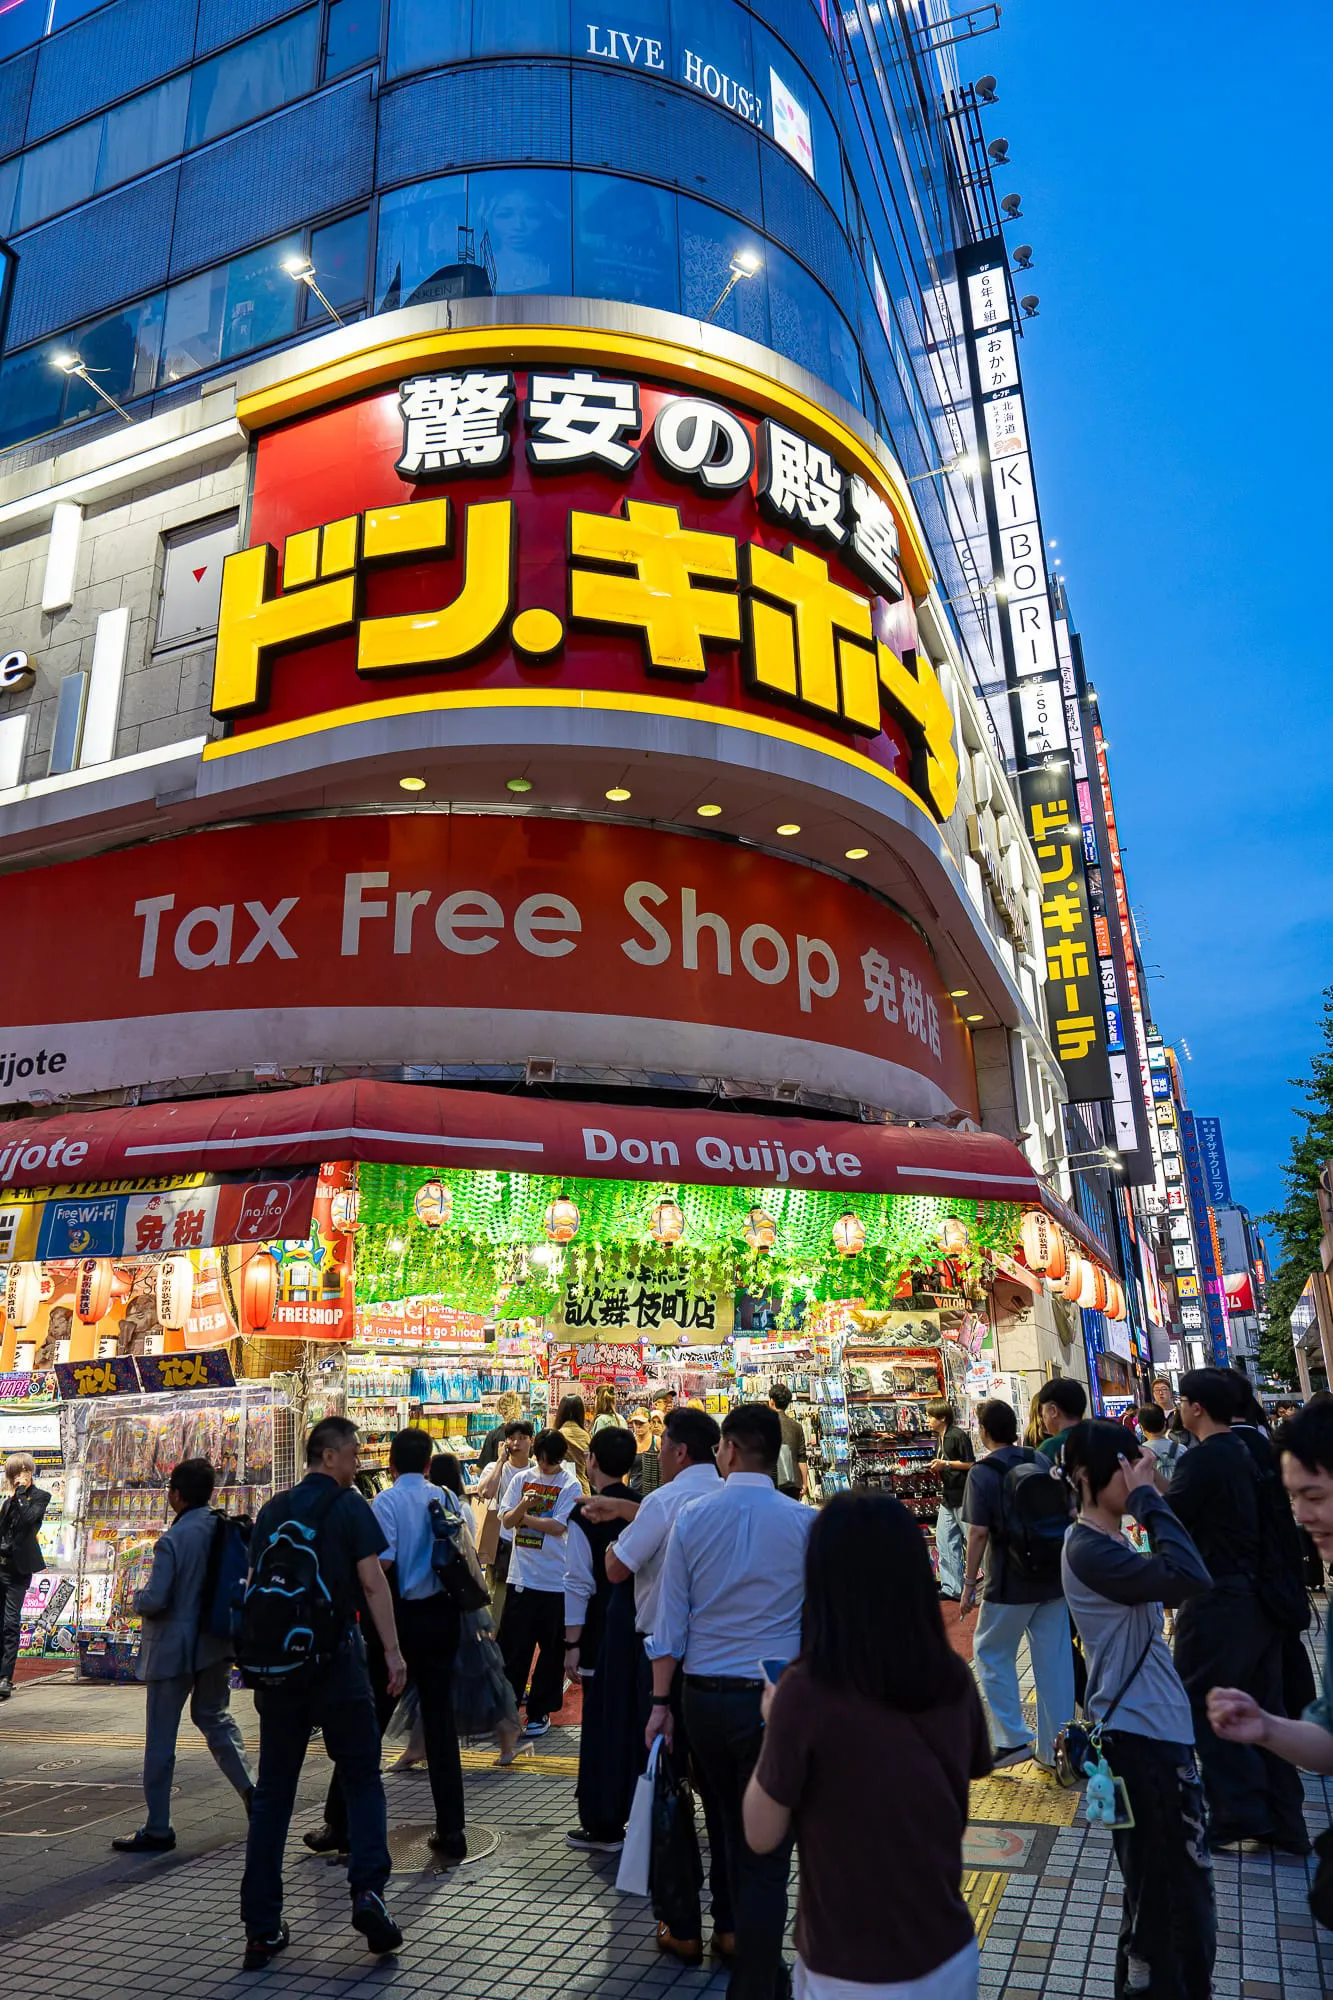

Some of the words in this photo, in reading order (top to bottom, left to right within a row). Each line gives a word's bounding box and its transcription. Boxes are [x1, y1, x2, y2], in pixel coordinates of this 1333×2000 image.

[586, 24, 664, 70] LIVE
[684, 48, 763, 130] HOUSE
[981, 275, 998, 324] 6年4組
[987, 338, 1007, 386] おかか
[992, 389, 1010, 399] 6-7F
[1002, 400, 1017, 435] 北海道
[396, 371, 903, 599] 驚安の殿堂
[1000, 461, 1042, 665] KIBORI
[1032, 675, 1043, 683] 5F
[1030, 799, 1097, 1061] ドン・キホーテ
[134, 892, 299, 978] Tax
[340, 871, 582, 958] Free
[620, 880, 840, 1011] Shop
[861, 946, 942, 1063] 免税店
[582, 1127, 680, 1166] Don
[695, 1136, 862, 1182] Quijote
[1205, 1132, 1224, 1200] オザキクリニック
[57, 1207, 78, 1220] Free
[78, 1203, 115, 1223] Wi-Fi
[135, 1208, 206, 1252] 免税
[245, 1205, 282, 1217] majica
[309, 1308, 343, 1325] SHOP
[565, 1282, 717, 1330] 歌舞伎町店
[434, 1327, 448, 1339] go
[73, 1362, 117, 1394] 花火
[157, 1354, 208, 1387] 花火
